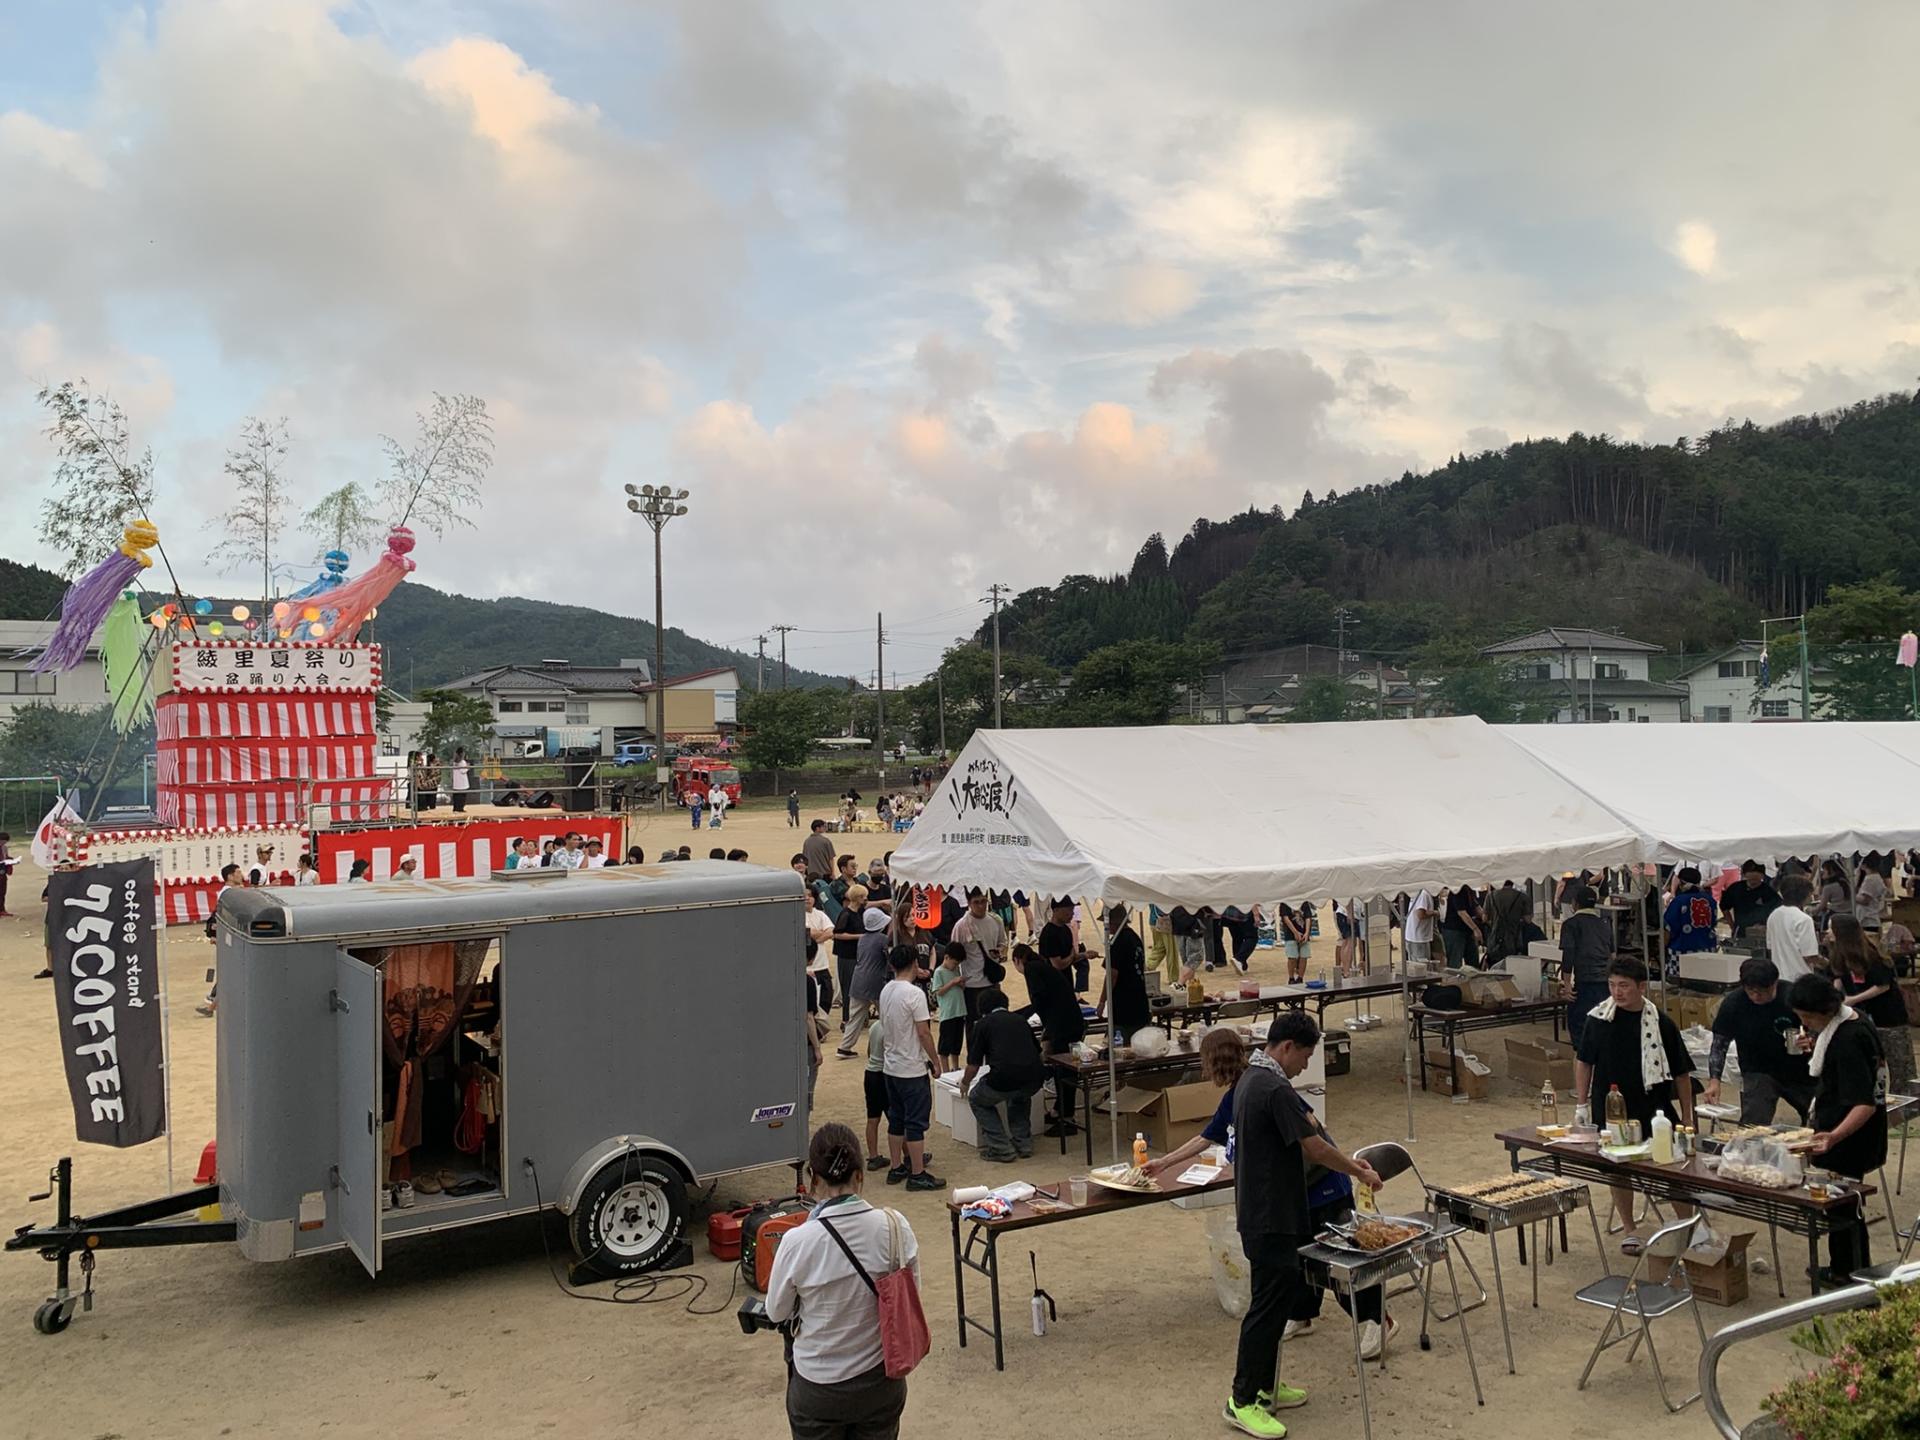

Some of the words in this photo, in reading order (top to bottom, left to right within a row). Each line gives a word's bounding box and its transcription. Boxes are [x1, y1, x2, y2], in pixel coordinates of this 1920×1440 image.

[197, 650, 355, 668] 綾里夏祭り
[123, 878, 141, 944] coffee
[126, 954, 146, 1008] stand
[620, 1216, 682, 1270] GOODYEAR
